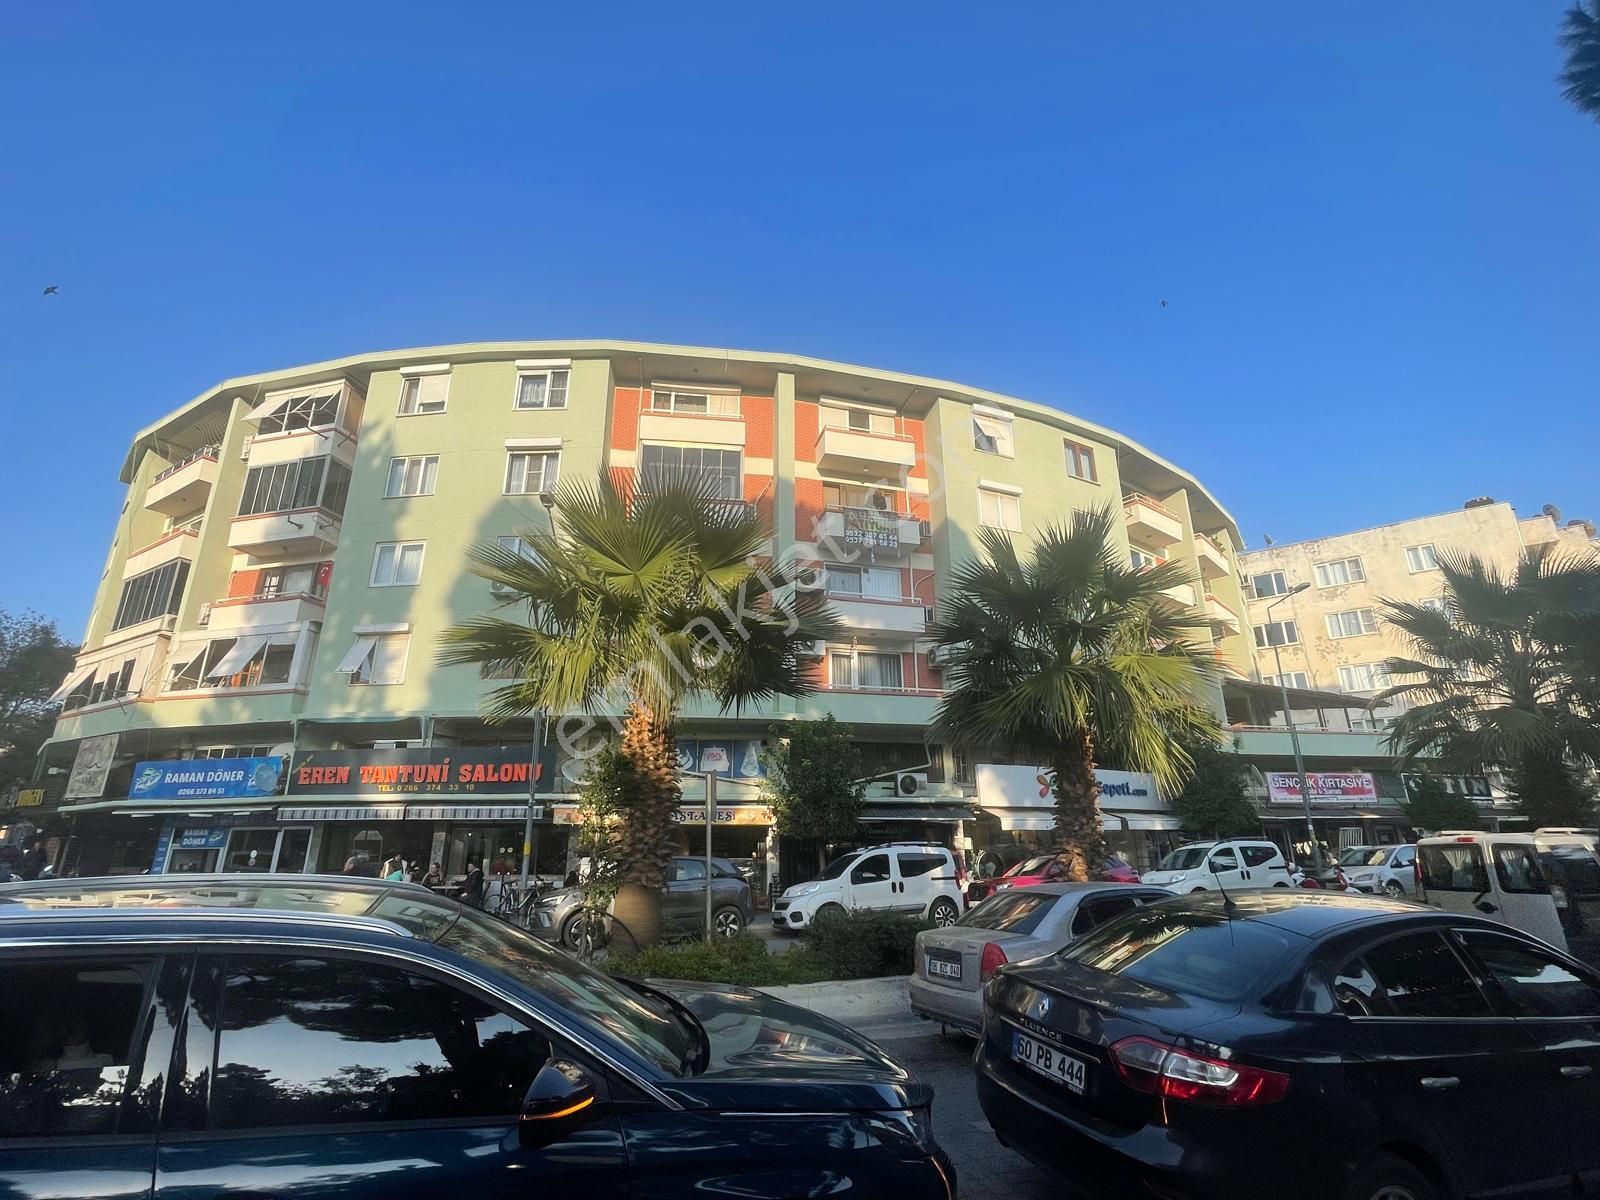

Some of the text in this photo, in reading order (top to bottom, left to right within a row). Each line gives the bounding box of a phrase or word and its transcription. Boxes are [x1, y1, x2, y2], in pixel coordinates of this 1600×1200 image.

[164, 768, 245, 784] RAMAN DÖNER
[298, 757, 543, 785] EREN TANTUNİ SALONU
[1271, 775, 1370, 790] GENÇİK KIRTASİYE
[182, 837, 206, 845] DÖNER
[1020, 1017, 1063, 1041] FLUENCE
[1018, 1036, 1032, 1060] 60
[1036, 1044, 1052, 1070] PB
[1057, 1056, 1084, 1086] 444
